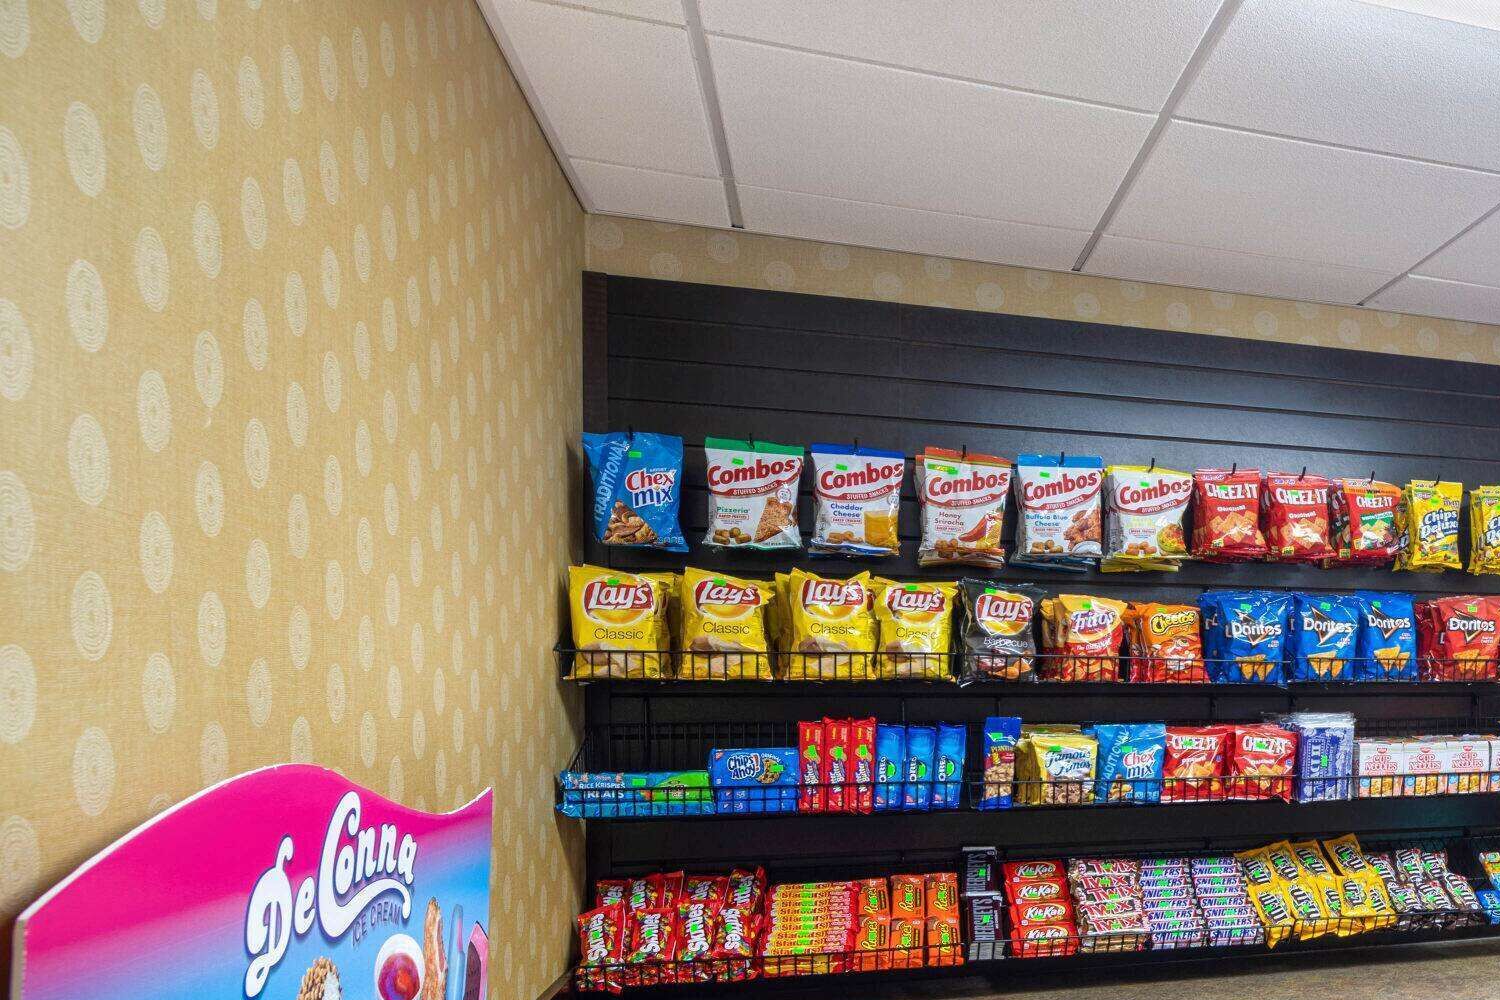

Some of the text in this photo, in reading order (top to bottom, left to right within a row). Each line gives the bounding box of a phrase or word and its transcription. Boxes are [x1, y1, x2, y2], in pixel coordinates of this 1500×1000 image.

[626, 469, 675, 491] Chex
[707, 458, 795, 487] Combos
[820, 463, 903, 490] Combos
[929, 471, 1008, 496] Combos
[1024, 472, 1098, 501] Combos
[1120, 478, 1191, 504] Combos
[633, 486, 673, 508] mix
[830, 503, 863, 511] Cheddar
[833, 510, 860, 518] Cheese
[939, 511, 961, 520] Honey
[1424, 510, 1457, 525] Chips
[1420, 520, 1458, 541] Deluxe
[703, 622, 750, 635] Classic
[810, 623, 856, 635] Classic
[1151, 611, 1197, 634] Cheetos
[1232, 622, 1282, 637] Doritos
[1303, 617, 1352, 634] Doritos
[1368, 615, 1411, 629] Doritos
[1449, 617, 1495, 633] Doritos
[594, 628, 644, 640] Classic
[896, 627, 937, 640] Classic
[727, 754, 754, 771] Chips
[1123, 751, 1155, 767] Chex
[939, 756, 947, 781] OREO
[1127, 762, 1154, 778] mix
[351, 902, 402, 946] ICE CREAM
